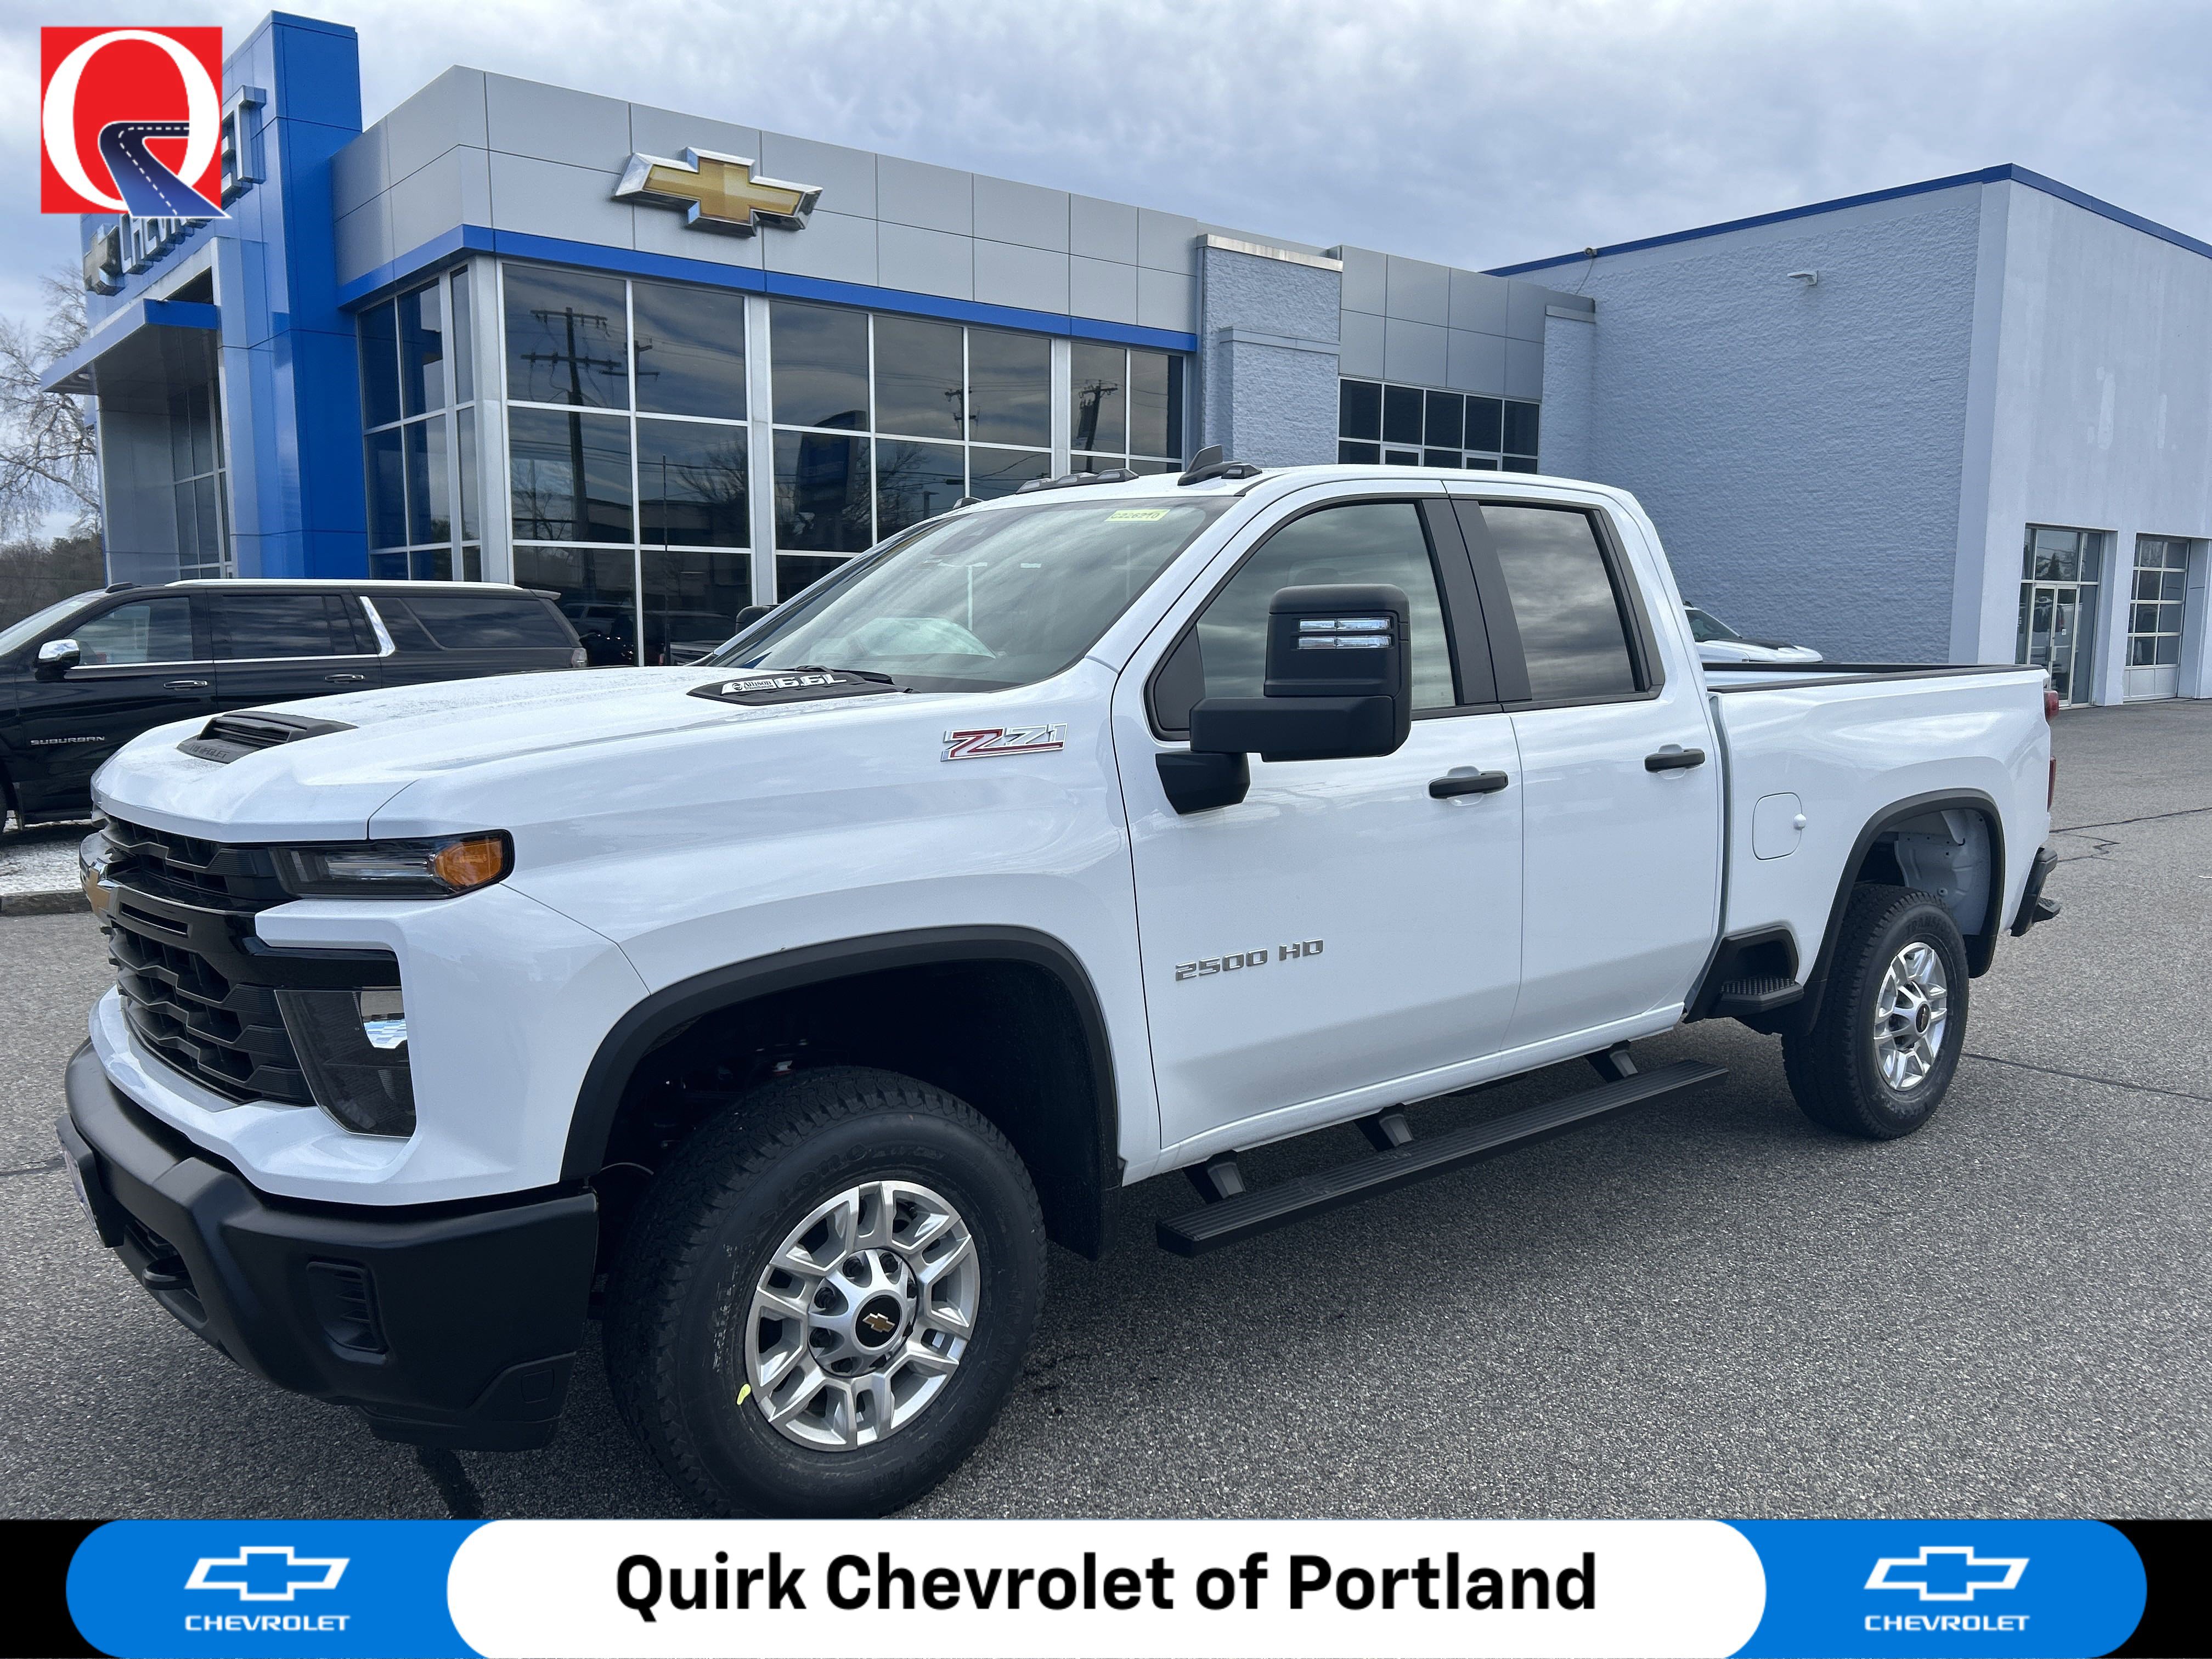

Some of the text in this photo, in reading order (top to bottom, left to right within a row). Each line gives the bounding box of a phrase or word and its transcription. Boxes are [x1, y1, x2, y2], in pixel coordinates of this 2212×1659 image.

[774, 674, 847, 689] 6.6L
[30, 736, 105, 745] SUBURBAN
[940, 723, 1068, 762] Z71
[1175, 938, 1323, 981] 2500 HD
